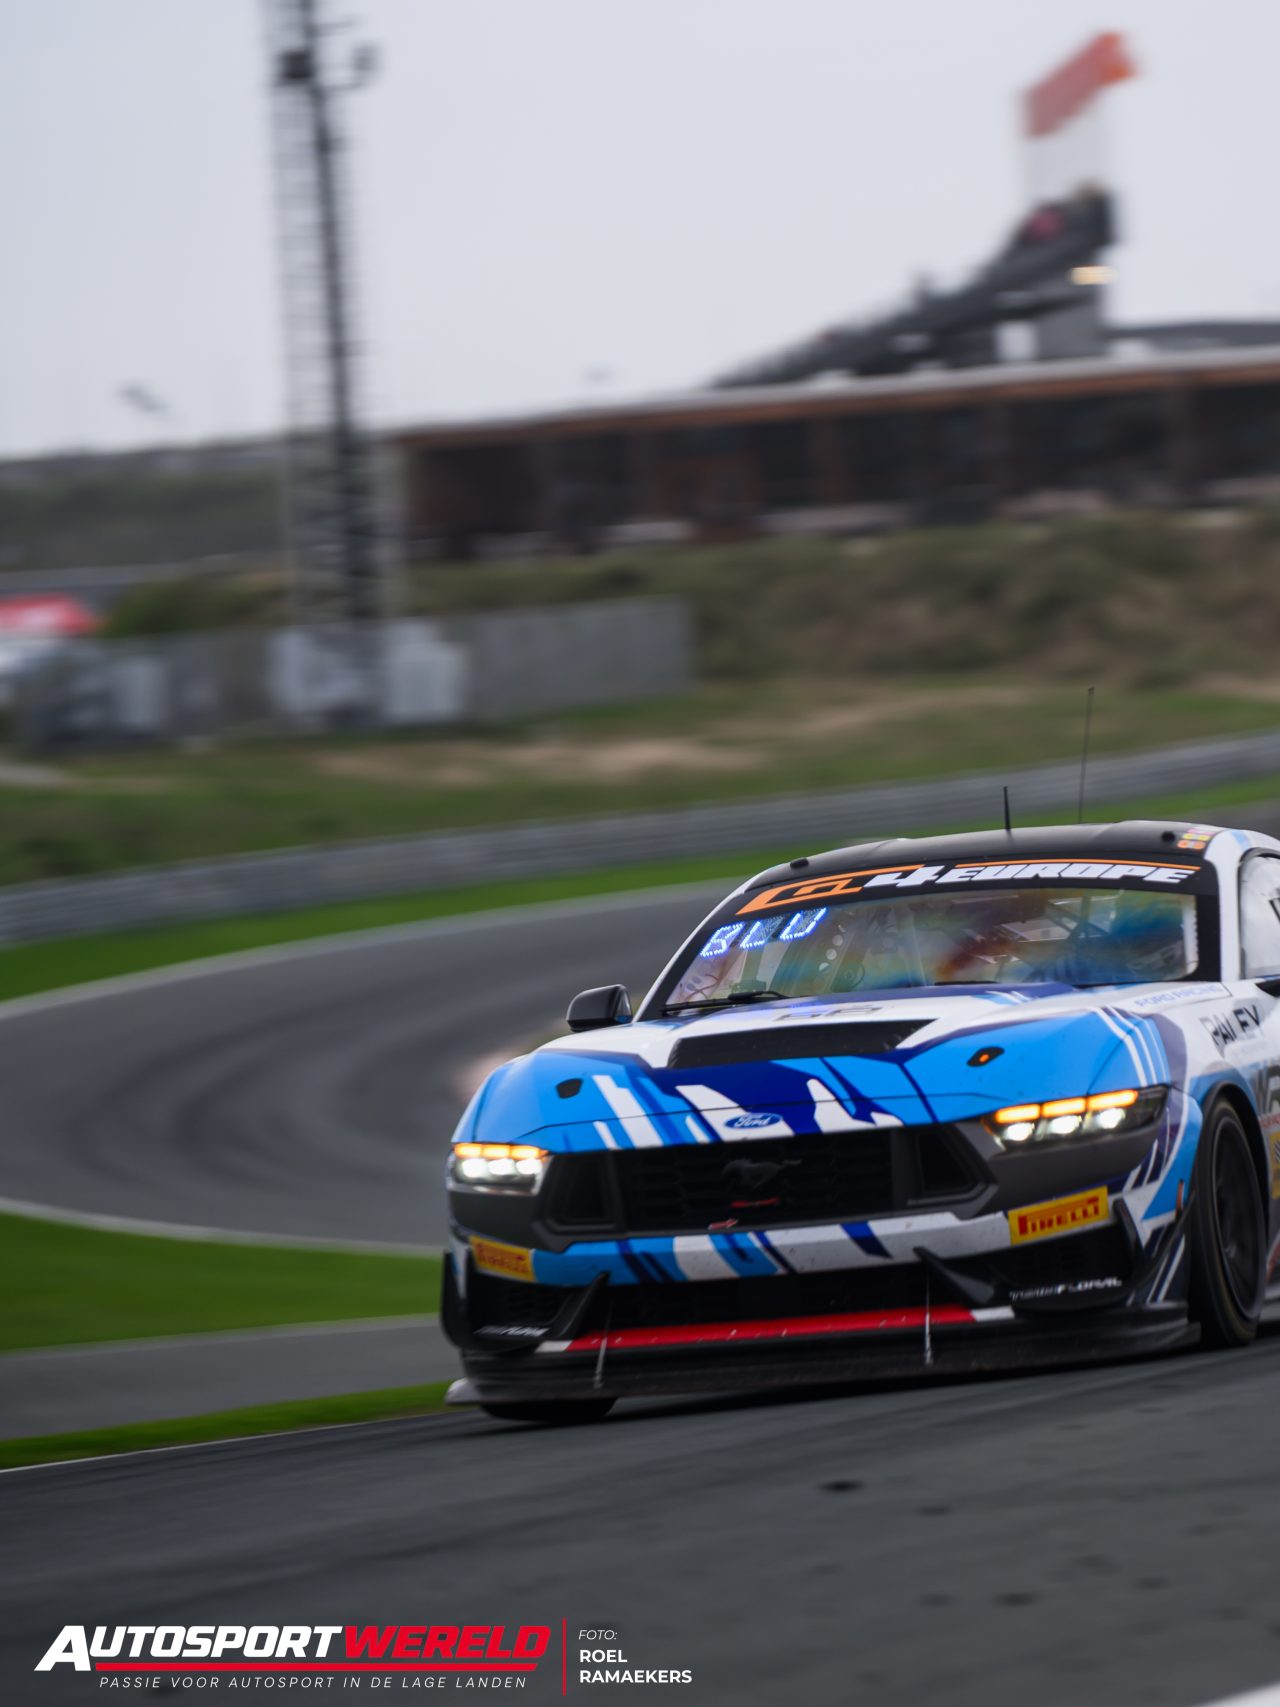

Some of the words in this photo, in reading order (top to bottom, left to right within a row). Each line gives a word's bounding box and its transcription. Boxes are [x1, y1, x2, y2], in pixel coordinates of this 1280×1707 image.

[934, 863, 1197, 884] EUROPE
[700, 906, 827, 957] BLU
[733, 1113, 772, 1129] Ford
[1018, 1196, 1100, 1236] PIRELLI
